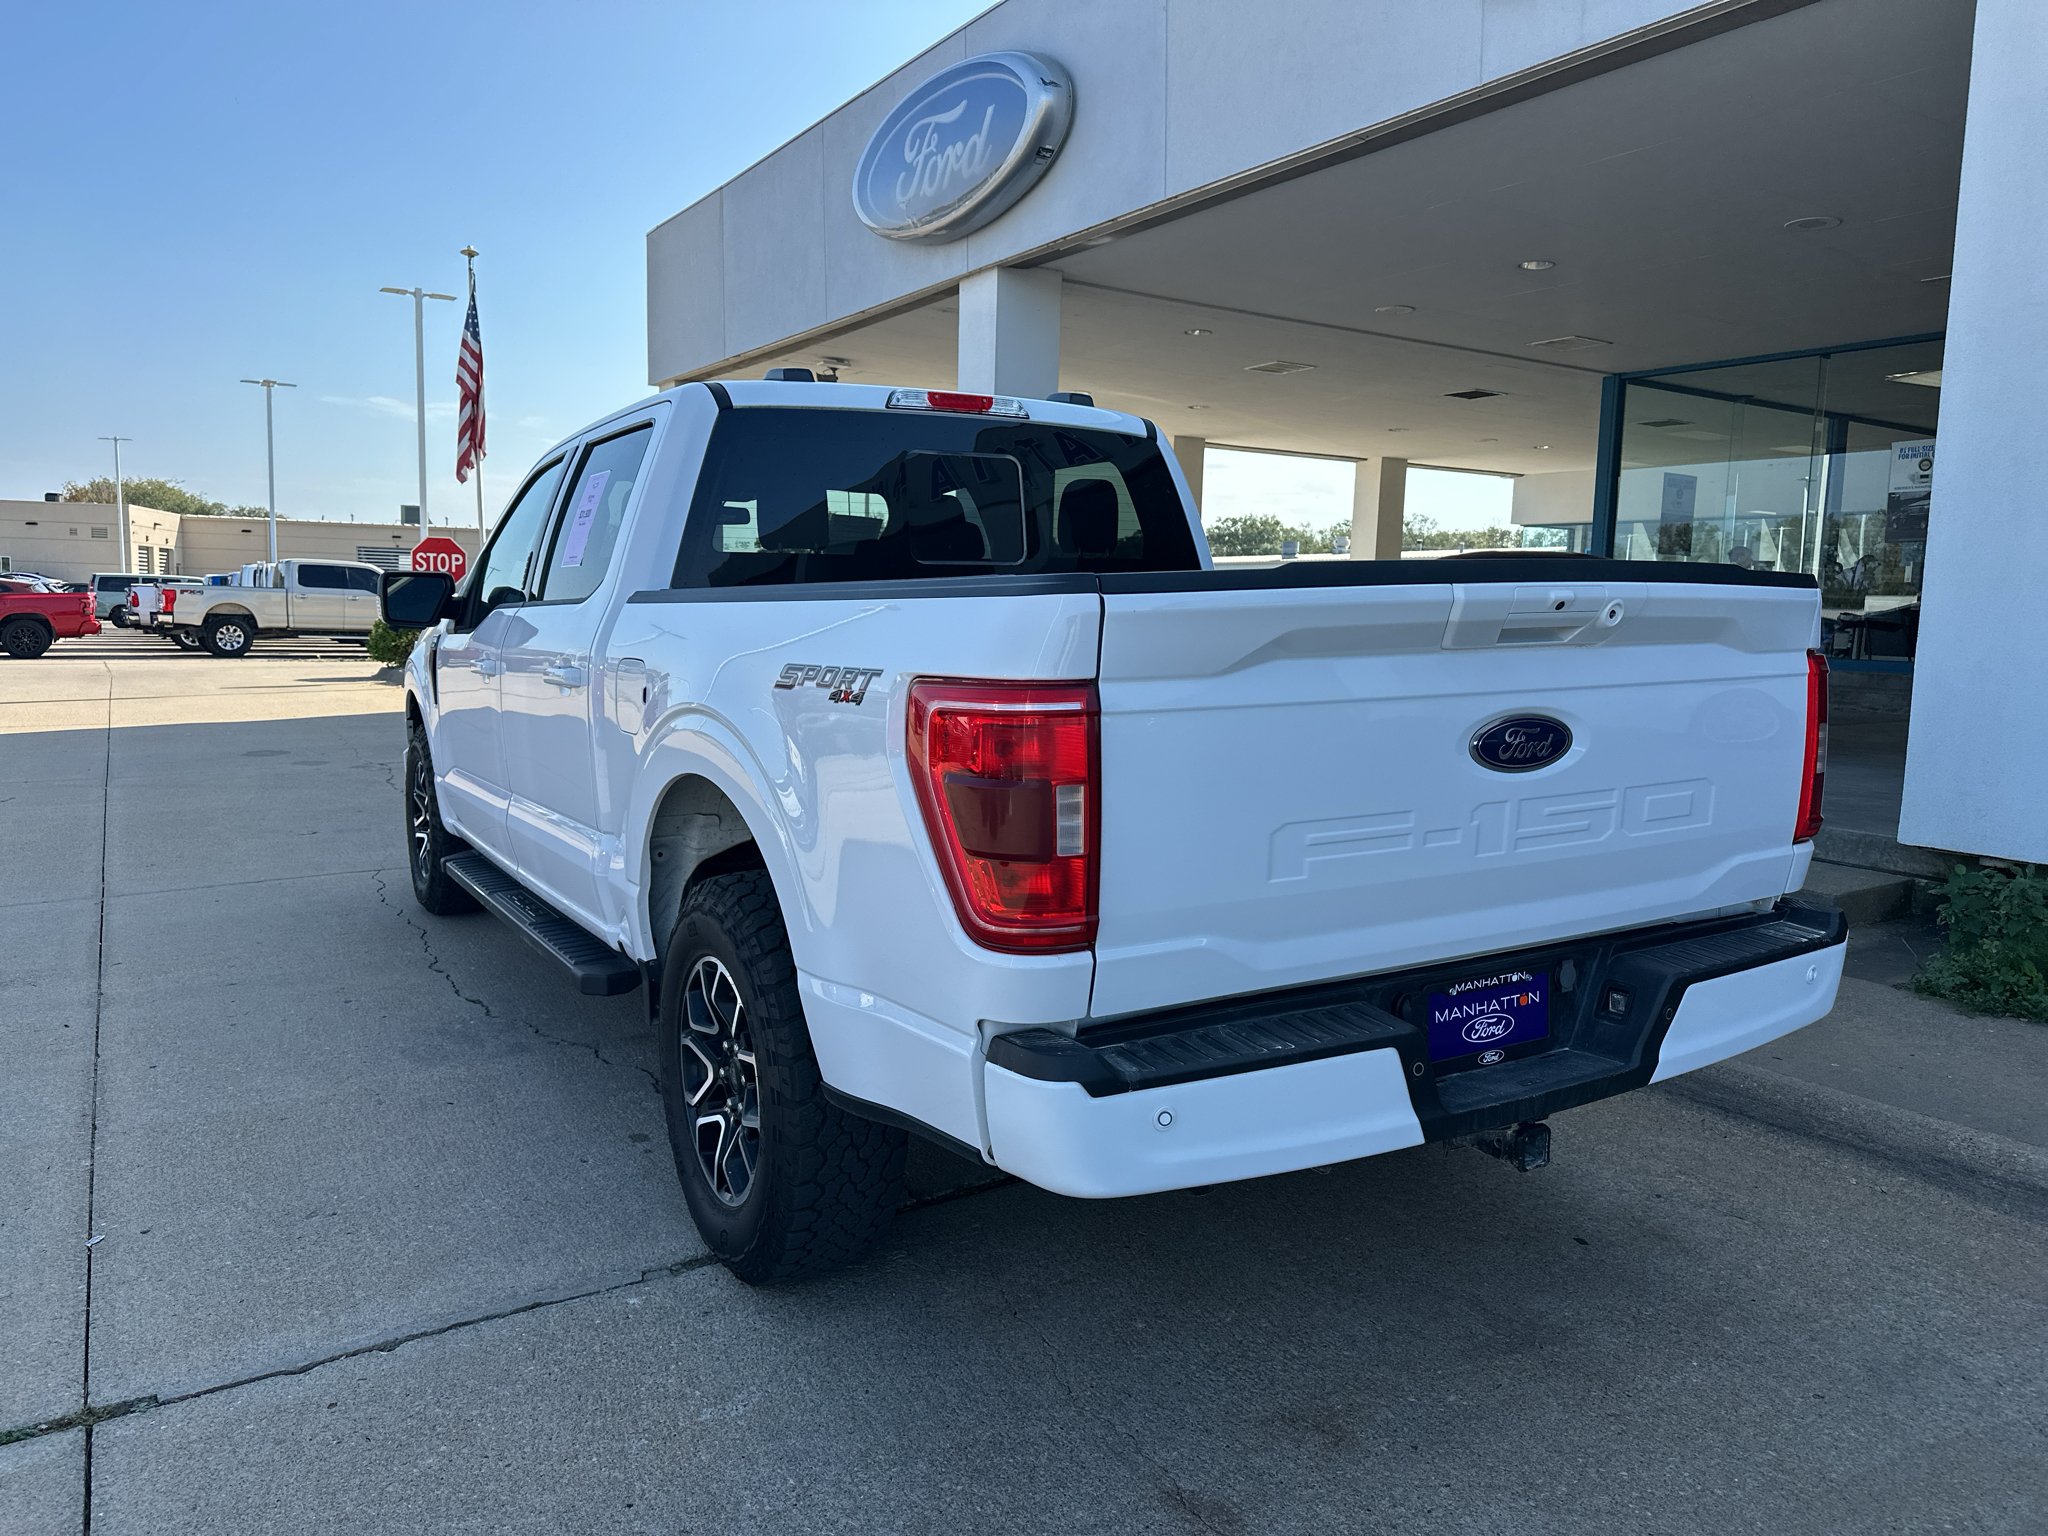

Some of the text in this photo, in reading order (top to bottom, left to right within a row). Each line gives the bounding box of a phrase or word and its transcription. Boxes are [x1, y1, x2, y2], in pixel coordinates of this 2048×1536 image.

[896, 99, 995, 202] Ford
[1910, 450, 1931, 459] INITIAL
[415, 552, 463, 572] STOP
[774, 663, 884, 692] SPORT
[1499, 727, 1553, 759] Ford
[1268, 777, 1715, 883] F-150
[1471, 1017, 1506, 1040] Ford
[1483, 1050, 1500, 1063] Ford
